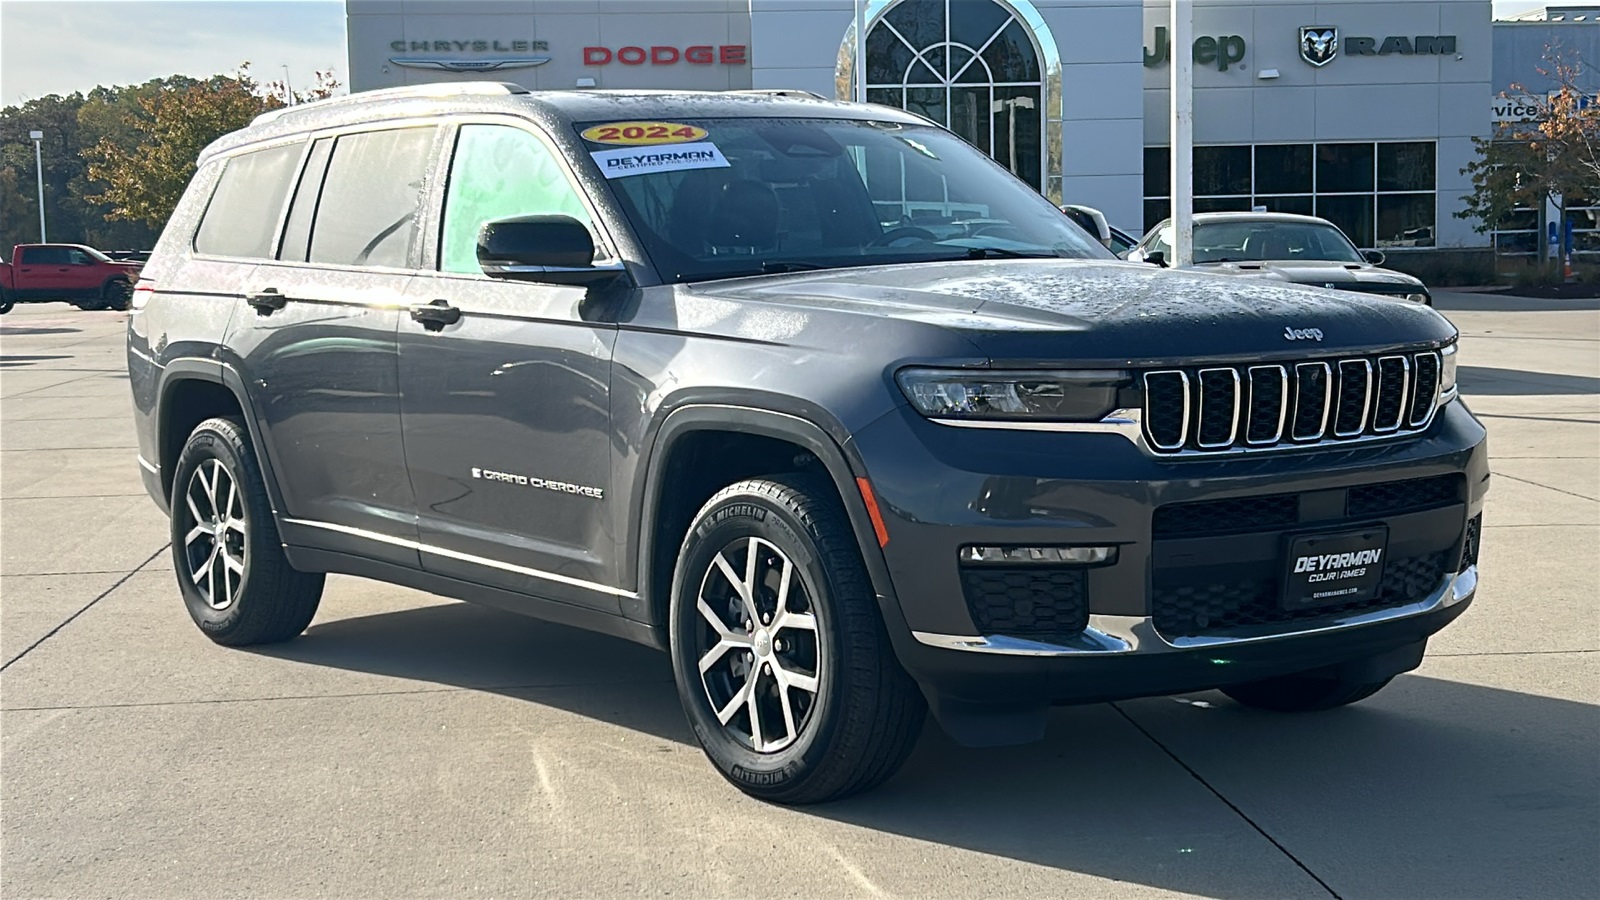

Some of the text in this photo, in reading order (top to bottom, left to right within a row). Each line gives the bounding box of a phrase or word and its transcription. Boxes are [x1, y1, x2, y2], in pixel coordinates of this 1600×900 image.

[390, 40, 549, 52] CHRYSLER
[1143, 26, 1246, 72] Jep
[1344, 35, 1457, 56] RAM
[583, 45, 747, 65] DODGE
[598, 126, 696, 141] 2024
[606, 150, 714, 168] DEYARMAN
[617, 161, 664, 170] CERTIFIED
[1284, 326, 1324, 342] Jeep
[483, 469, 604, 499] GRAND CHEROKEE
[716, 505, 766, 522] MICHELIN
[1293, 548, 1383, 573] DEYARMAN
[1339, 567, 1367, 580] AMES
